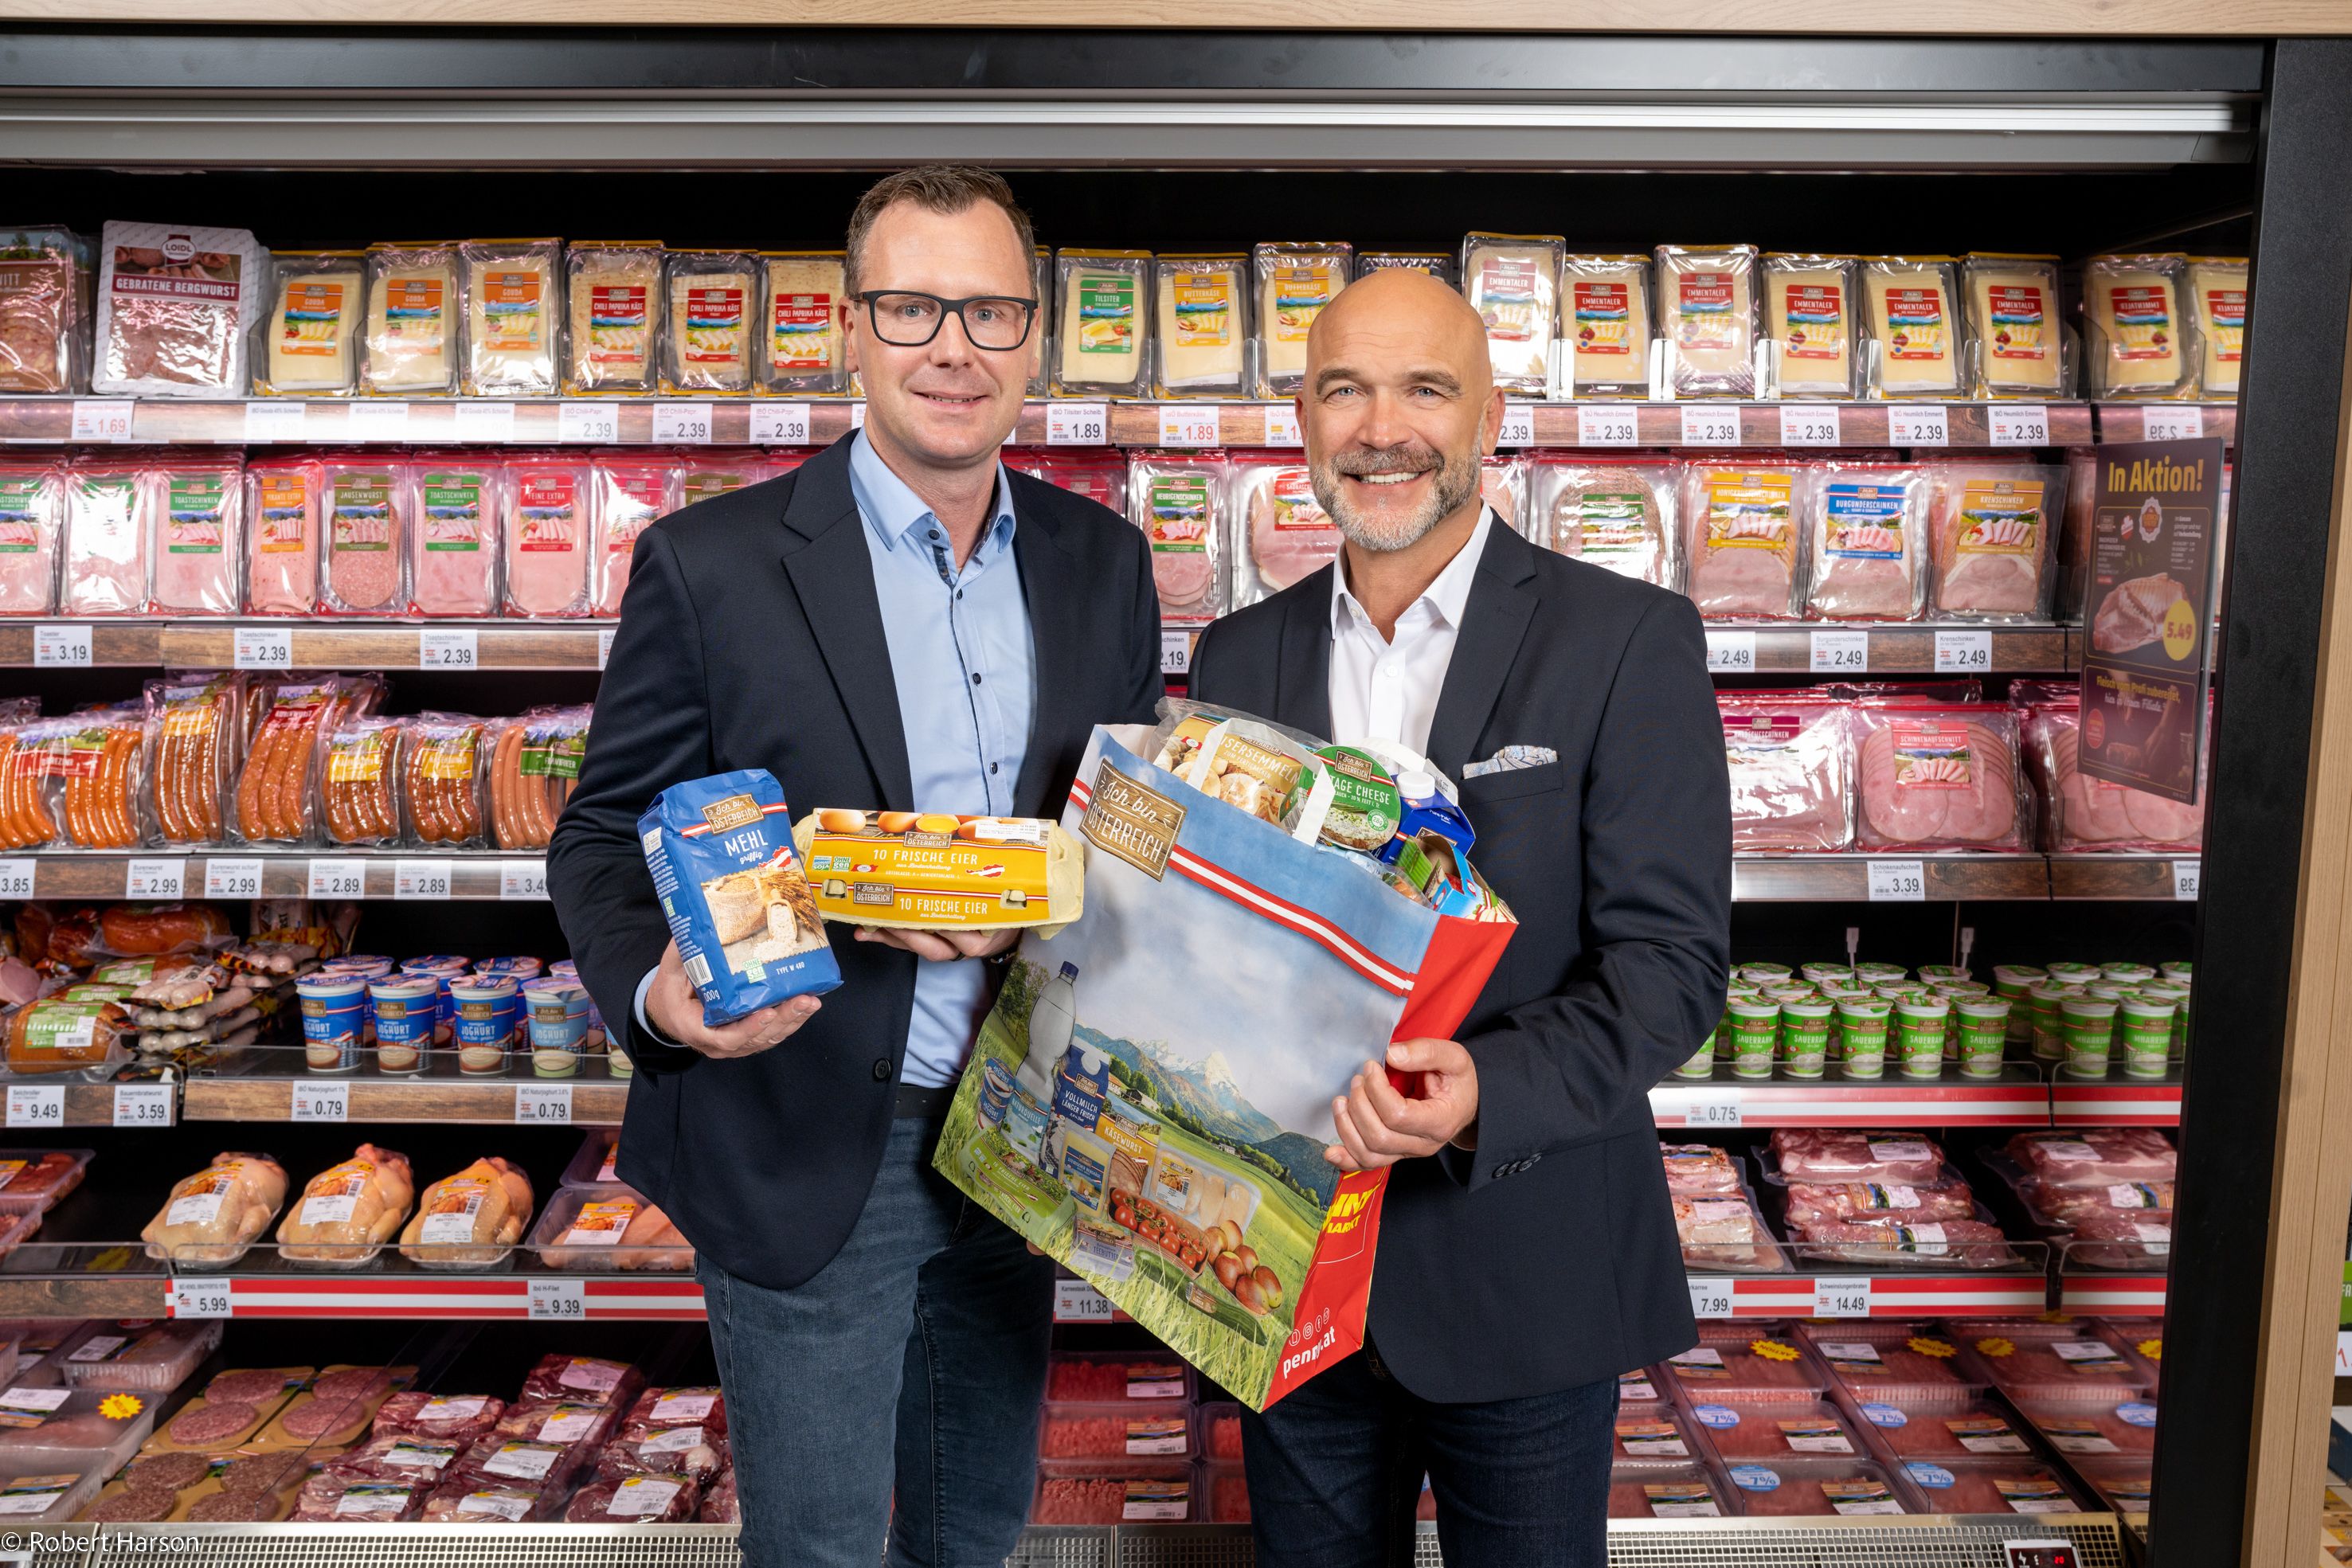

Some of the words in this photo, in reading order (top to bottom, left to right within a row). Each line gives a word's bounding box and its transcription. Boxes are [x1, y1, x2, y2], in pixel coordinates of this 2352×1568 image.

[165, 243, 192, 252] LOIDL
[116, 278, 172, 292] GEBRATENE
[175, 282, 237, 297] BERGWURST
[1489, 278, 1528, 287] EMMENTALER
[405, 295, 425, 303] GOUDA
[1095, 295, 1120, 303] TILSITER
[1184, 288, 1220, 298] BUTTERKÄSE
[1687, 289, 1726, 298] EMMENTALER
[305, 296, 325, 306] GOUDA
[594, 303, 607, 311] CHILI
[609, 303, 628, 311] PAPRIKA
[630, 302, 644, 311] KÄSE
[690, 303, 703, 312] CHILI
[726, 303, 740, 312] KÄSE
[1582, 297, 1621, 306] EMMENTALER
[1794, 300, 1833, 311] EMMENTALER
[1894, 302, 1933, 311] EMMENTALER
[1997, 301, 2035, 311] EMMENTALER
[777, 309, 791, 318] CHILI
[792, 309, 813, 318] PAPRIKA
[815, 308, 828, 318] KÄSE
[98, 419, 126, 433] 1.69
[583, 423, 612, 438] 2.39
[678, 423, 706, 438] 2.39
[775, 423, 803, 438] 2.39
[1073, 423, 1100, 439] 1.89
[1186, 424, 1214, 440] 1.89
[1501, 425, 1528, 440] 2.39
[1604, 425, 1632, 440] 2.39
[1706, 424, 1734, 440] 2.39
[1806, 424, 1833, 440] 2.39
[1914, 425, 1943, 440] 2.39
[2015, 424, 2043, 440] 2.39
[2107, 462, 2125, 492] In
[2129, 456, 2204, 492] Aktion!
[340, 491, 383, 499] JAUSENWURST
[1156, 492, 1203, 502] HEURIGENSCHINKEN
[1980, 495, 2025, 504] KRENSCHINKEN
[1835, 499, 1898, 510] BURGUNDERSCHINKEN
[2166, 620, 2193, 641] 5.49
[60, 646, 87, 660] 3.19
[259, 646, 286, 661] 2.39
[444, 649, 471, 663] 2.39
[1722, 650, 1749, 665] 2.49
[1835, 651, 1862, 665] 2.49
[1959, 650, 1986, 665] 2.49
[1900, 735, 1962, 744] SCHINKENAUFSCHNITT
[1221, 736, 1300, 785] ISERSEMMELN
[1337, 760, 1368, 779] ÖSTERREICH
[1103, 780, 1129, 807] Ich
[1132, 796, 1159, 824] bin
[1356, 784, 1391, 805] CHEESE
[713, 807, 759, 829] ÖSTERREICH
[1087, 798, 1164, 864] ÖSTERREICH
[724, 829, 769, 857] MEHL
[907, 839, 947, 847] ÖSTERREICH
[739, 850, 764, 865] griffig
[873, 849, 887, 860] 10
[894, 850, 945, 863] FRISCHE
[951, 853, 978, 865] EIER
[1, 878, 28, 892] 3.85
[151, 878, 178, 893] 2.99
[229, 878, 256, 893] 2.99
[332, 878, 359, 893] 2.89
[418, 878, 445, 893] 2.89
[1892, 878, 1919, 893] 3.39
[856, 892, 890, 902] ÖSTERREICH
[899, 897, 912, 910] 10
[917, 898, 960, 913] FRISCHE
[965, 901, 988, 915] EIER
[745, 958, 761, 968] OHNE
[776, 967, 789, 976] TYPE
[304, 1023, 331, 1034] JOGHURT
[378, 1023, 409, 1035] JOGHURT
[461, 1025, 495, 1036] JOGHURT
[535, 1027, 569, 1038] JOGHURT
[315, 1101, 342, 1116] 0.79
[1065, 1089, 1098, 1113] VOLLMILCH
[31, 1104, 58, 1118] 9.49
[138, 1104, 165, 1118] 3.59
[538, 1103, 565, 1118] 0.79
[1061, 1098, 1079, 1114] LÄNGER
[1080, 1109, 1096, 1122] FRISCH
[1708, 1106, 1736, 1120] 0.75
[1104, 1125, 1142, 1154] KÄSEWURST
[1819, 1282, 1867, 1291] Schweinslungenbraten
[199, 1297, 227, 1312] 5.99
[552, 1300, 580, 1314] 9.39
[1078, 1300, 1108, 1314] 11.38
[1700, 1298, 1728, 1312] 7.99
[1837, 1296, 1865, 1312] 14.49
[1283, 1325, 1336, 1379] penny.at
